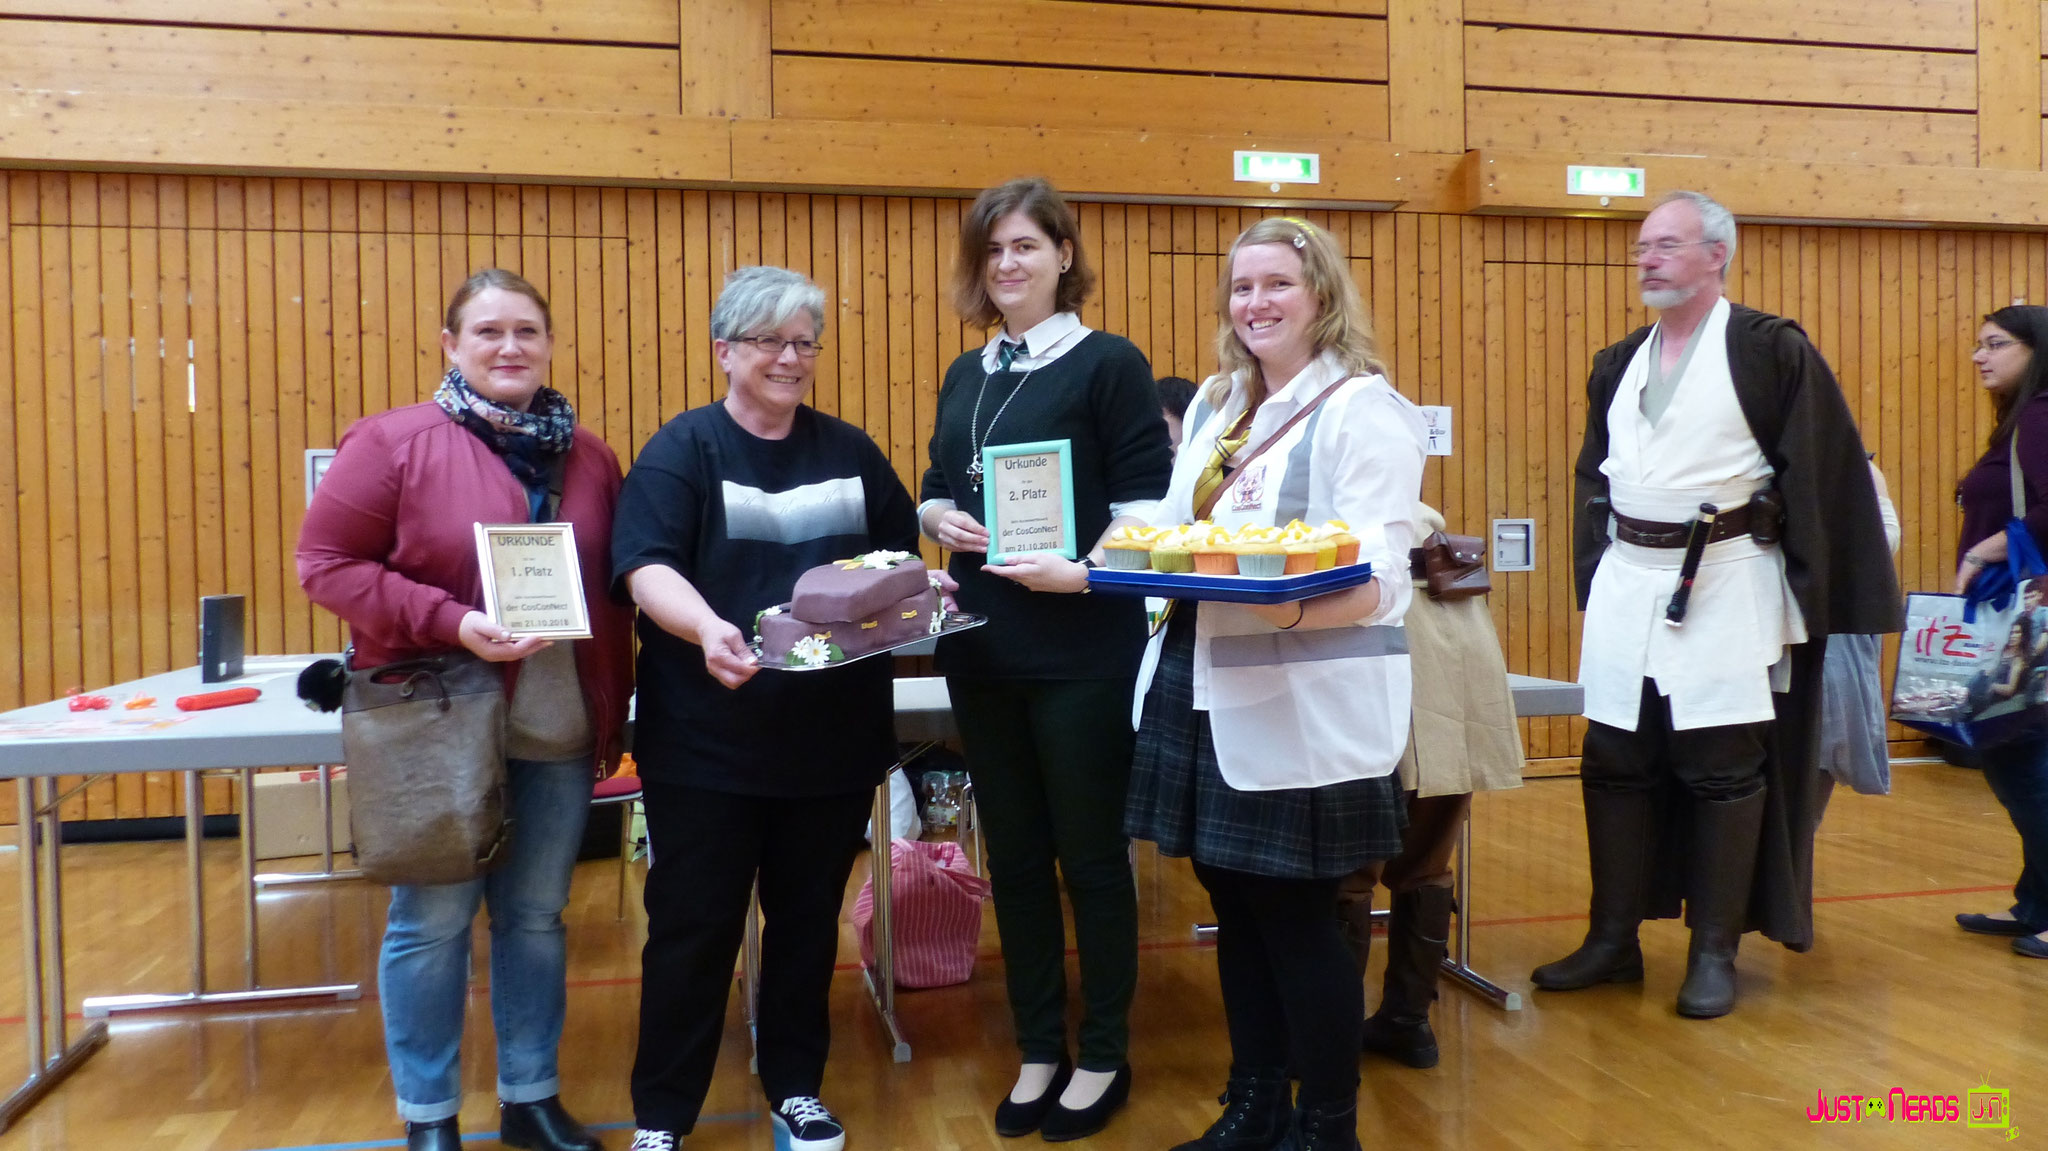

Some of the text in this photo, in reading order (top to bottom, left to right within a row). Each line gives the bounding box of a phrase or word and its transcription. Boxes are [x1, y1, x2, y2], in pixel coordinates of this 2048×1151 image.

[1005, 457, 1048, 470] Urkunde
[1009, 489, 1047, 501] 2. Platz
[1002, 528, 1013, 536] der
[498, 536, 555, 546] URKUNDE
[511, 566, 553, 577] 1. Platz
[506, 604, 518, 612] der
